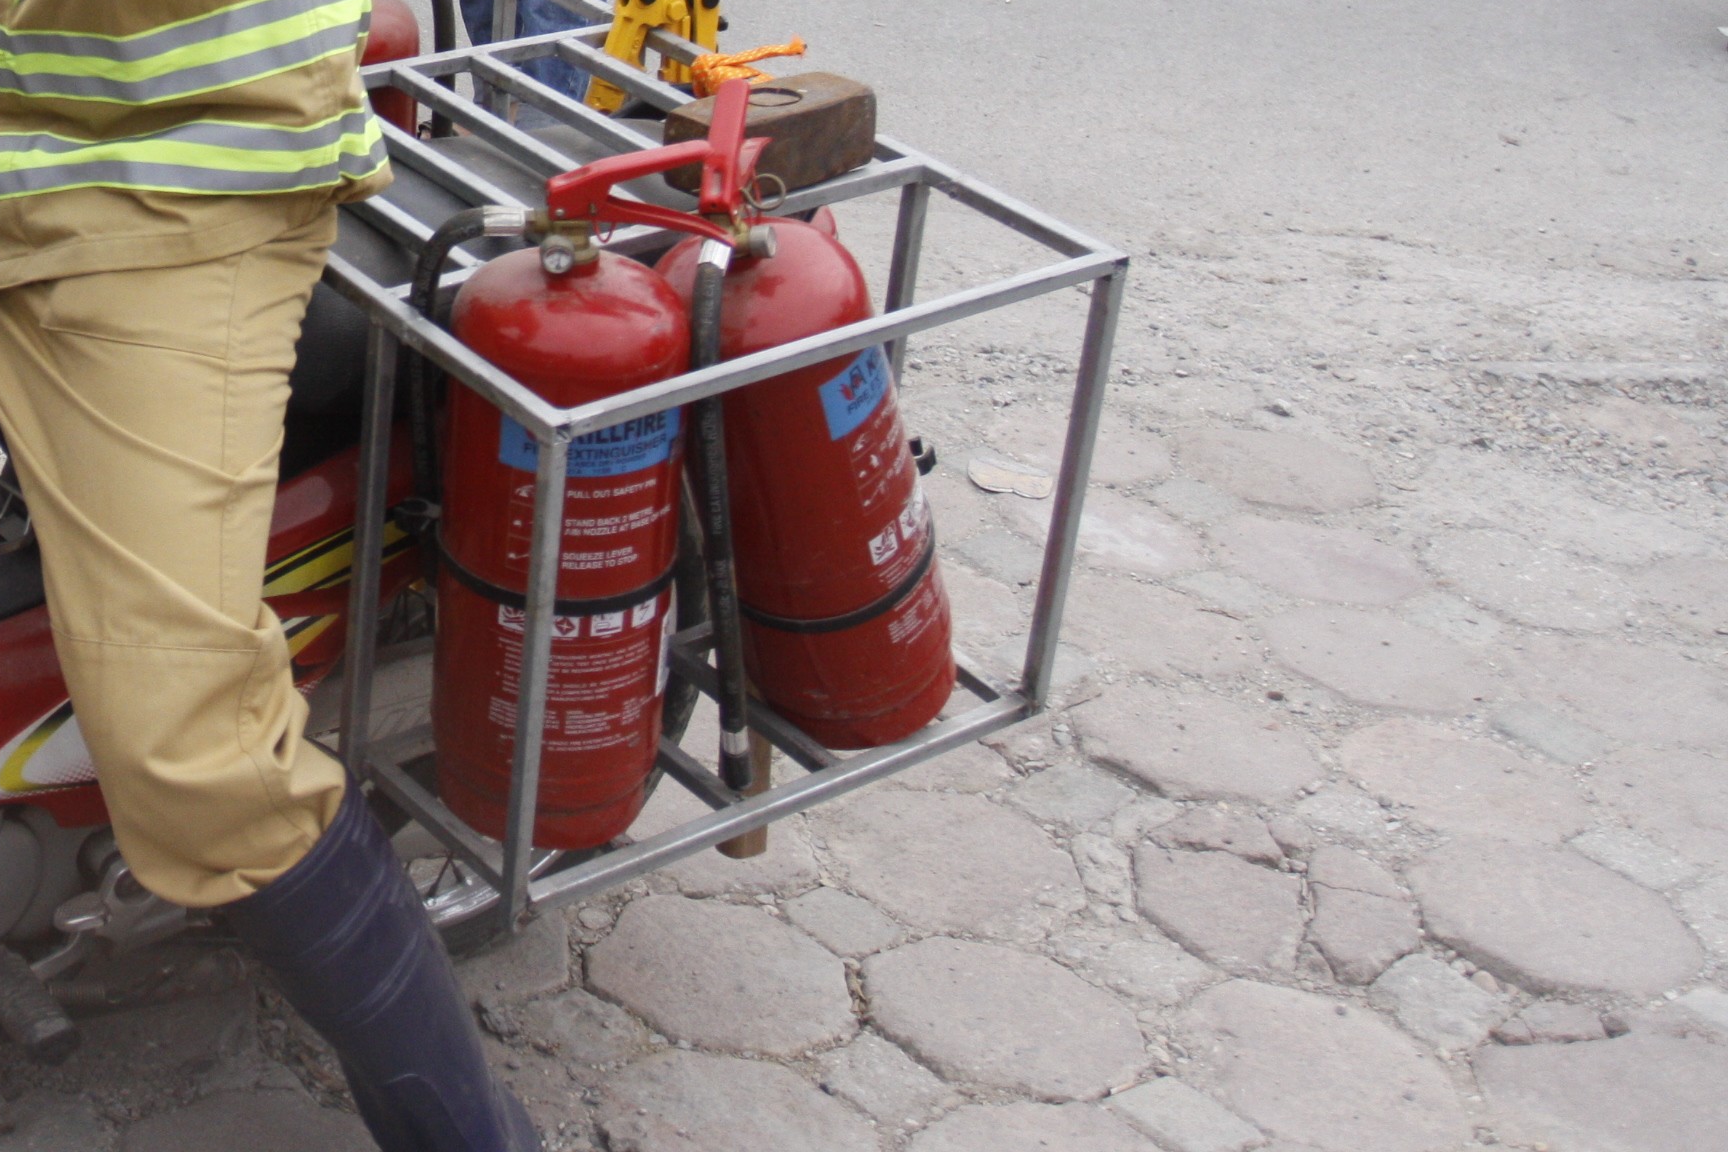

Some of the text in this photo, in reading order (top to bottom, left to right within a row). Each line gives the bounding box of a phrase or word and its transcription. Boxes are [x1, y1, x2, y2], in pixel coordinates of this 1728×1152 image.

[567, 490, 591, 499] PULL
[592, 489, 611, 498] OUT
[613, 482, 643, 497] SAFETY
[565, 519, 595, 528] STAND
[597, 516, 620, 527] BACK
[583, 526, 617, 536] NOZZLE
[562, 546, 633, 561] SQUEEZE LEVER
[562, 554, 638, 570] RELEASE TO STOP
